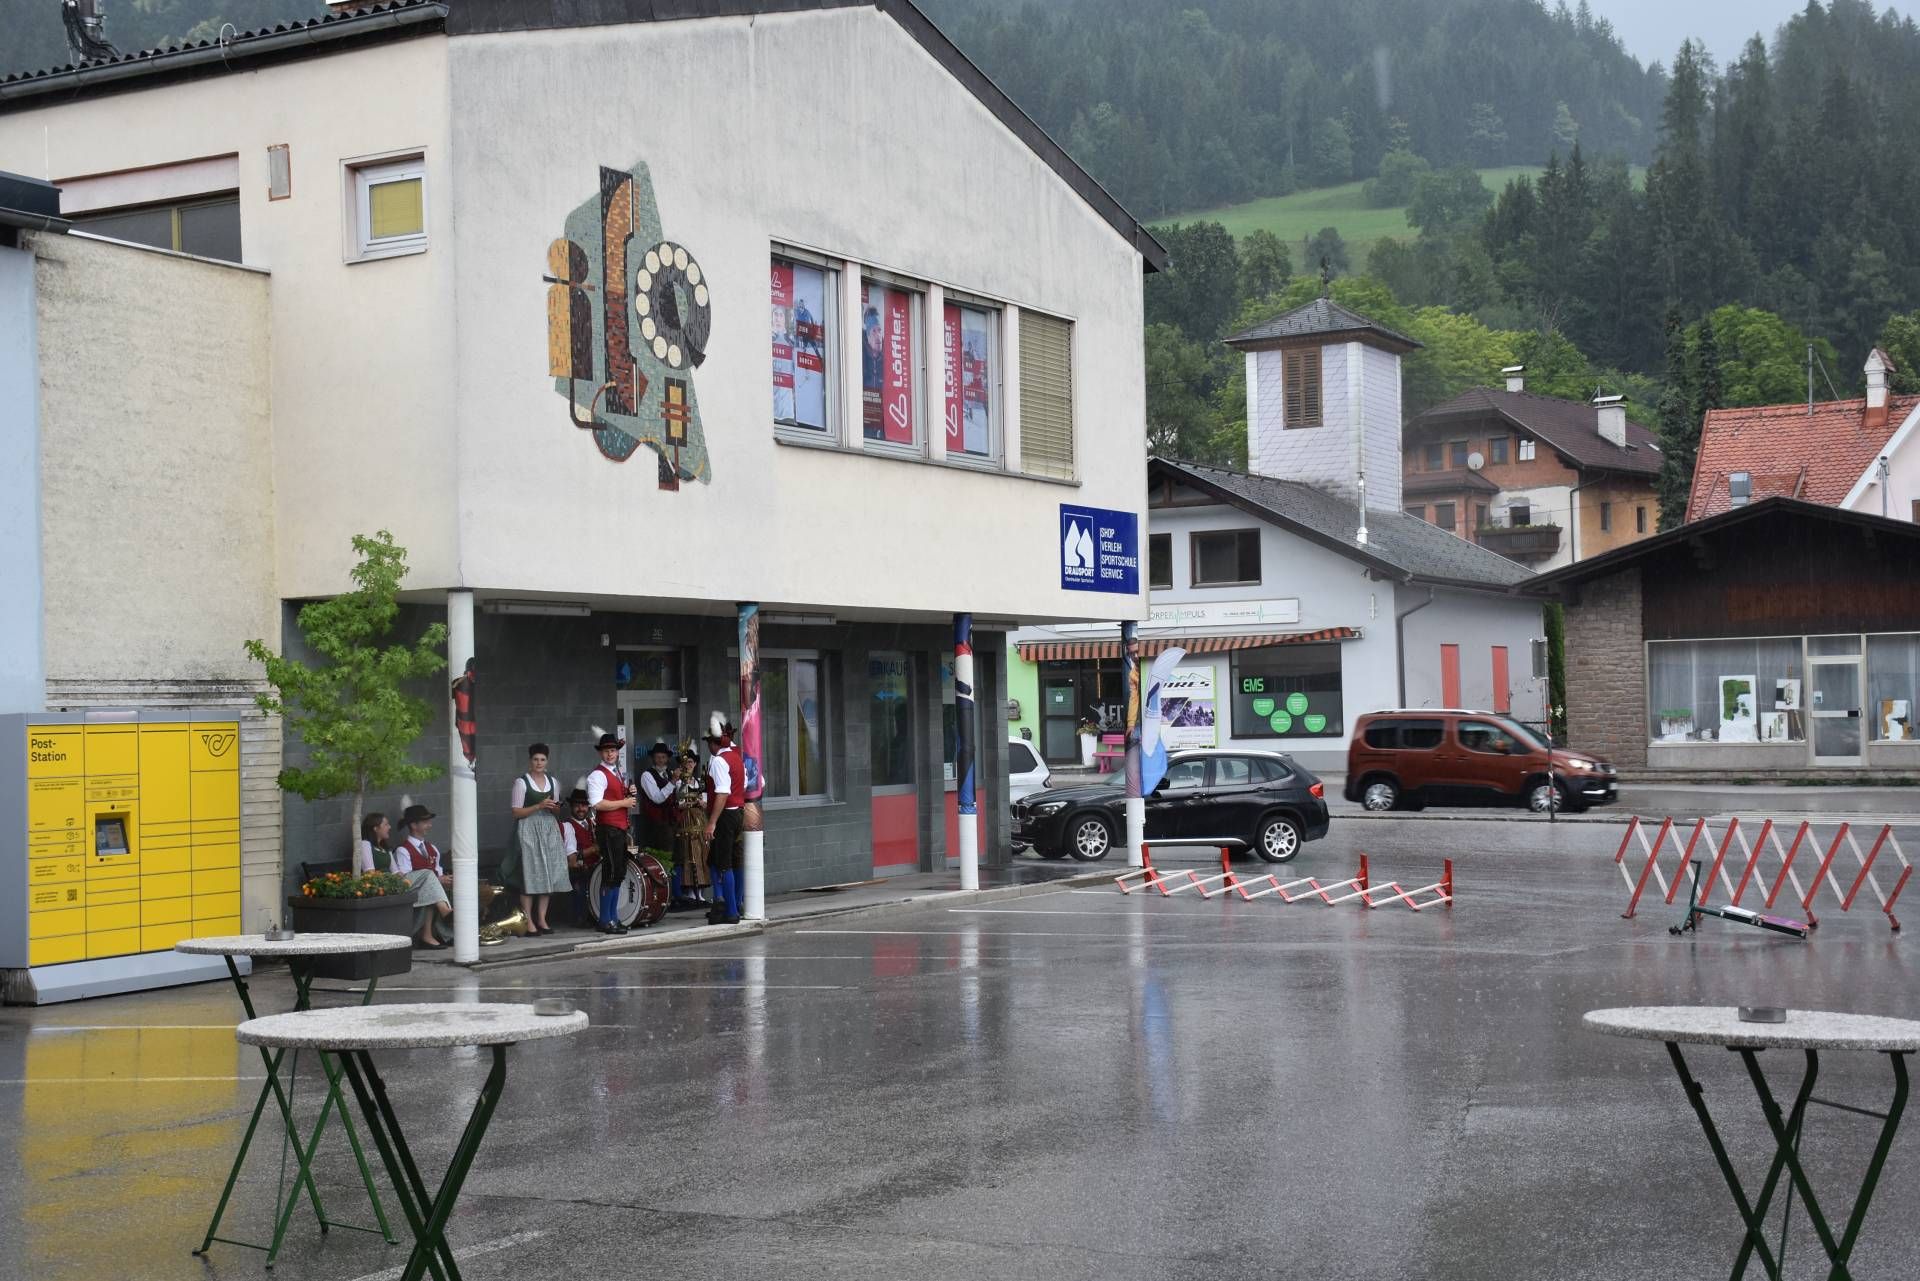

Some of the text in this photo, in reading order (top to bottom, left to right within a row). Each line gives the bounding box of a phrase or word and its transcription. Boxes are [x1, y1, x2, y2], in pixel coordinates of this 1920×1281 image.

[891, 307, 903, 388] Löffler
[943, 321, 954, 397] Löffler
[1101, 527, 1115, 538] SHOP
[1101, 541, 1123, 553] VERLEIH
[1101, 554, 1137, 568] SPORTSCHULE
[1064, 566, 1095, 577] DRAUSPORT
[1101, 567, 1124, 580] SERVICE
[1243, 677, 1265, 693] EMS
[31, 738, 57, 749] Post-
[31, 751, 67, 762] Station
